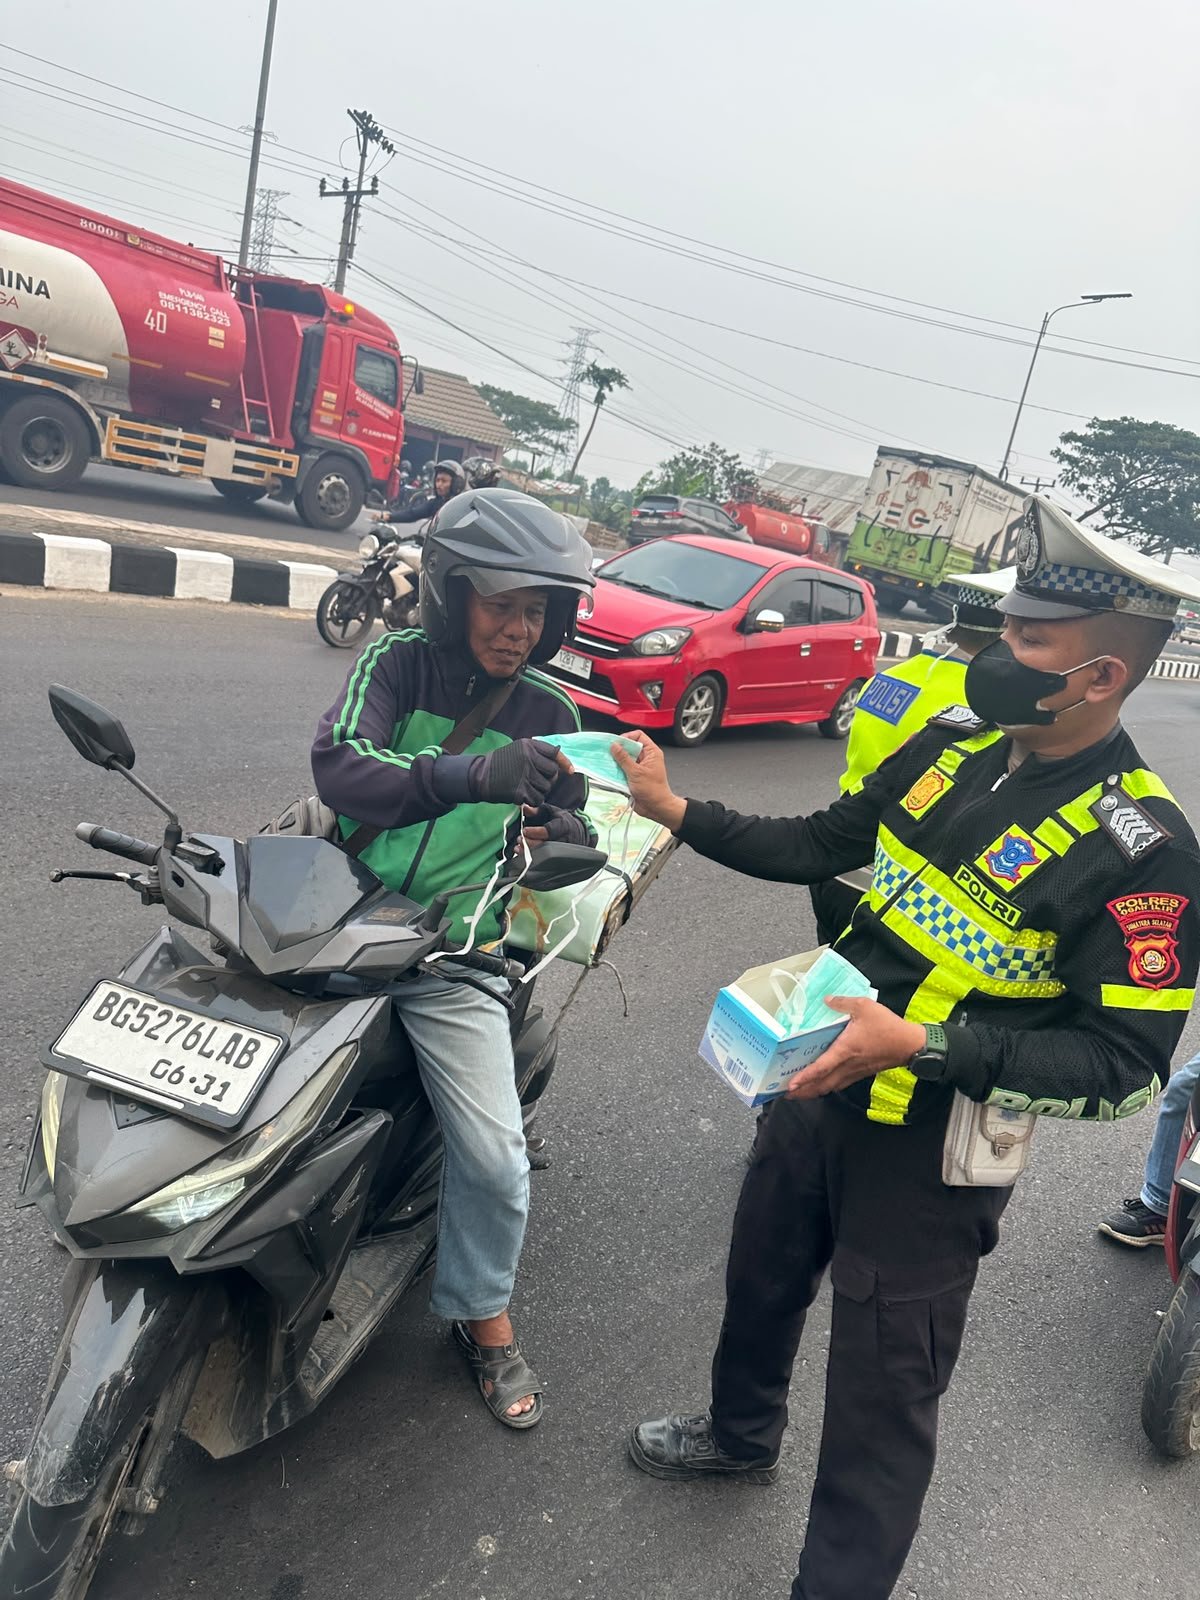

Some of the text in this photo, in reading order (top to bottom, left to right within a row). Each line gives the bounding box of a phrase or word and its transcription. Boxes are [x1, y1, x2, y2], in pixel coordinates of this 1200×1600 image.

[158, 290, 207, 312] EMERGENCY
[210, 306, 230, 319] CALL
[864, 678, 914, 720] POLISI
[1131, 830, 1165, 857] POLISI
[957, 870, 1017, 923] POLRI
[1115, 896, 1180, 912] POLRES
[1151, 904, 1174, 913] ILIR
